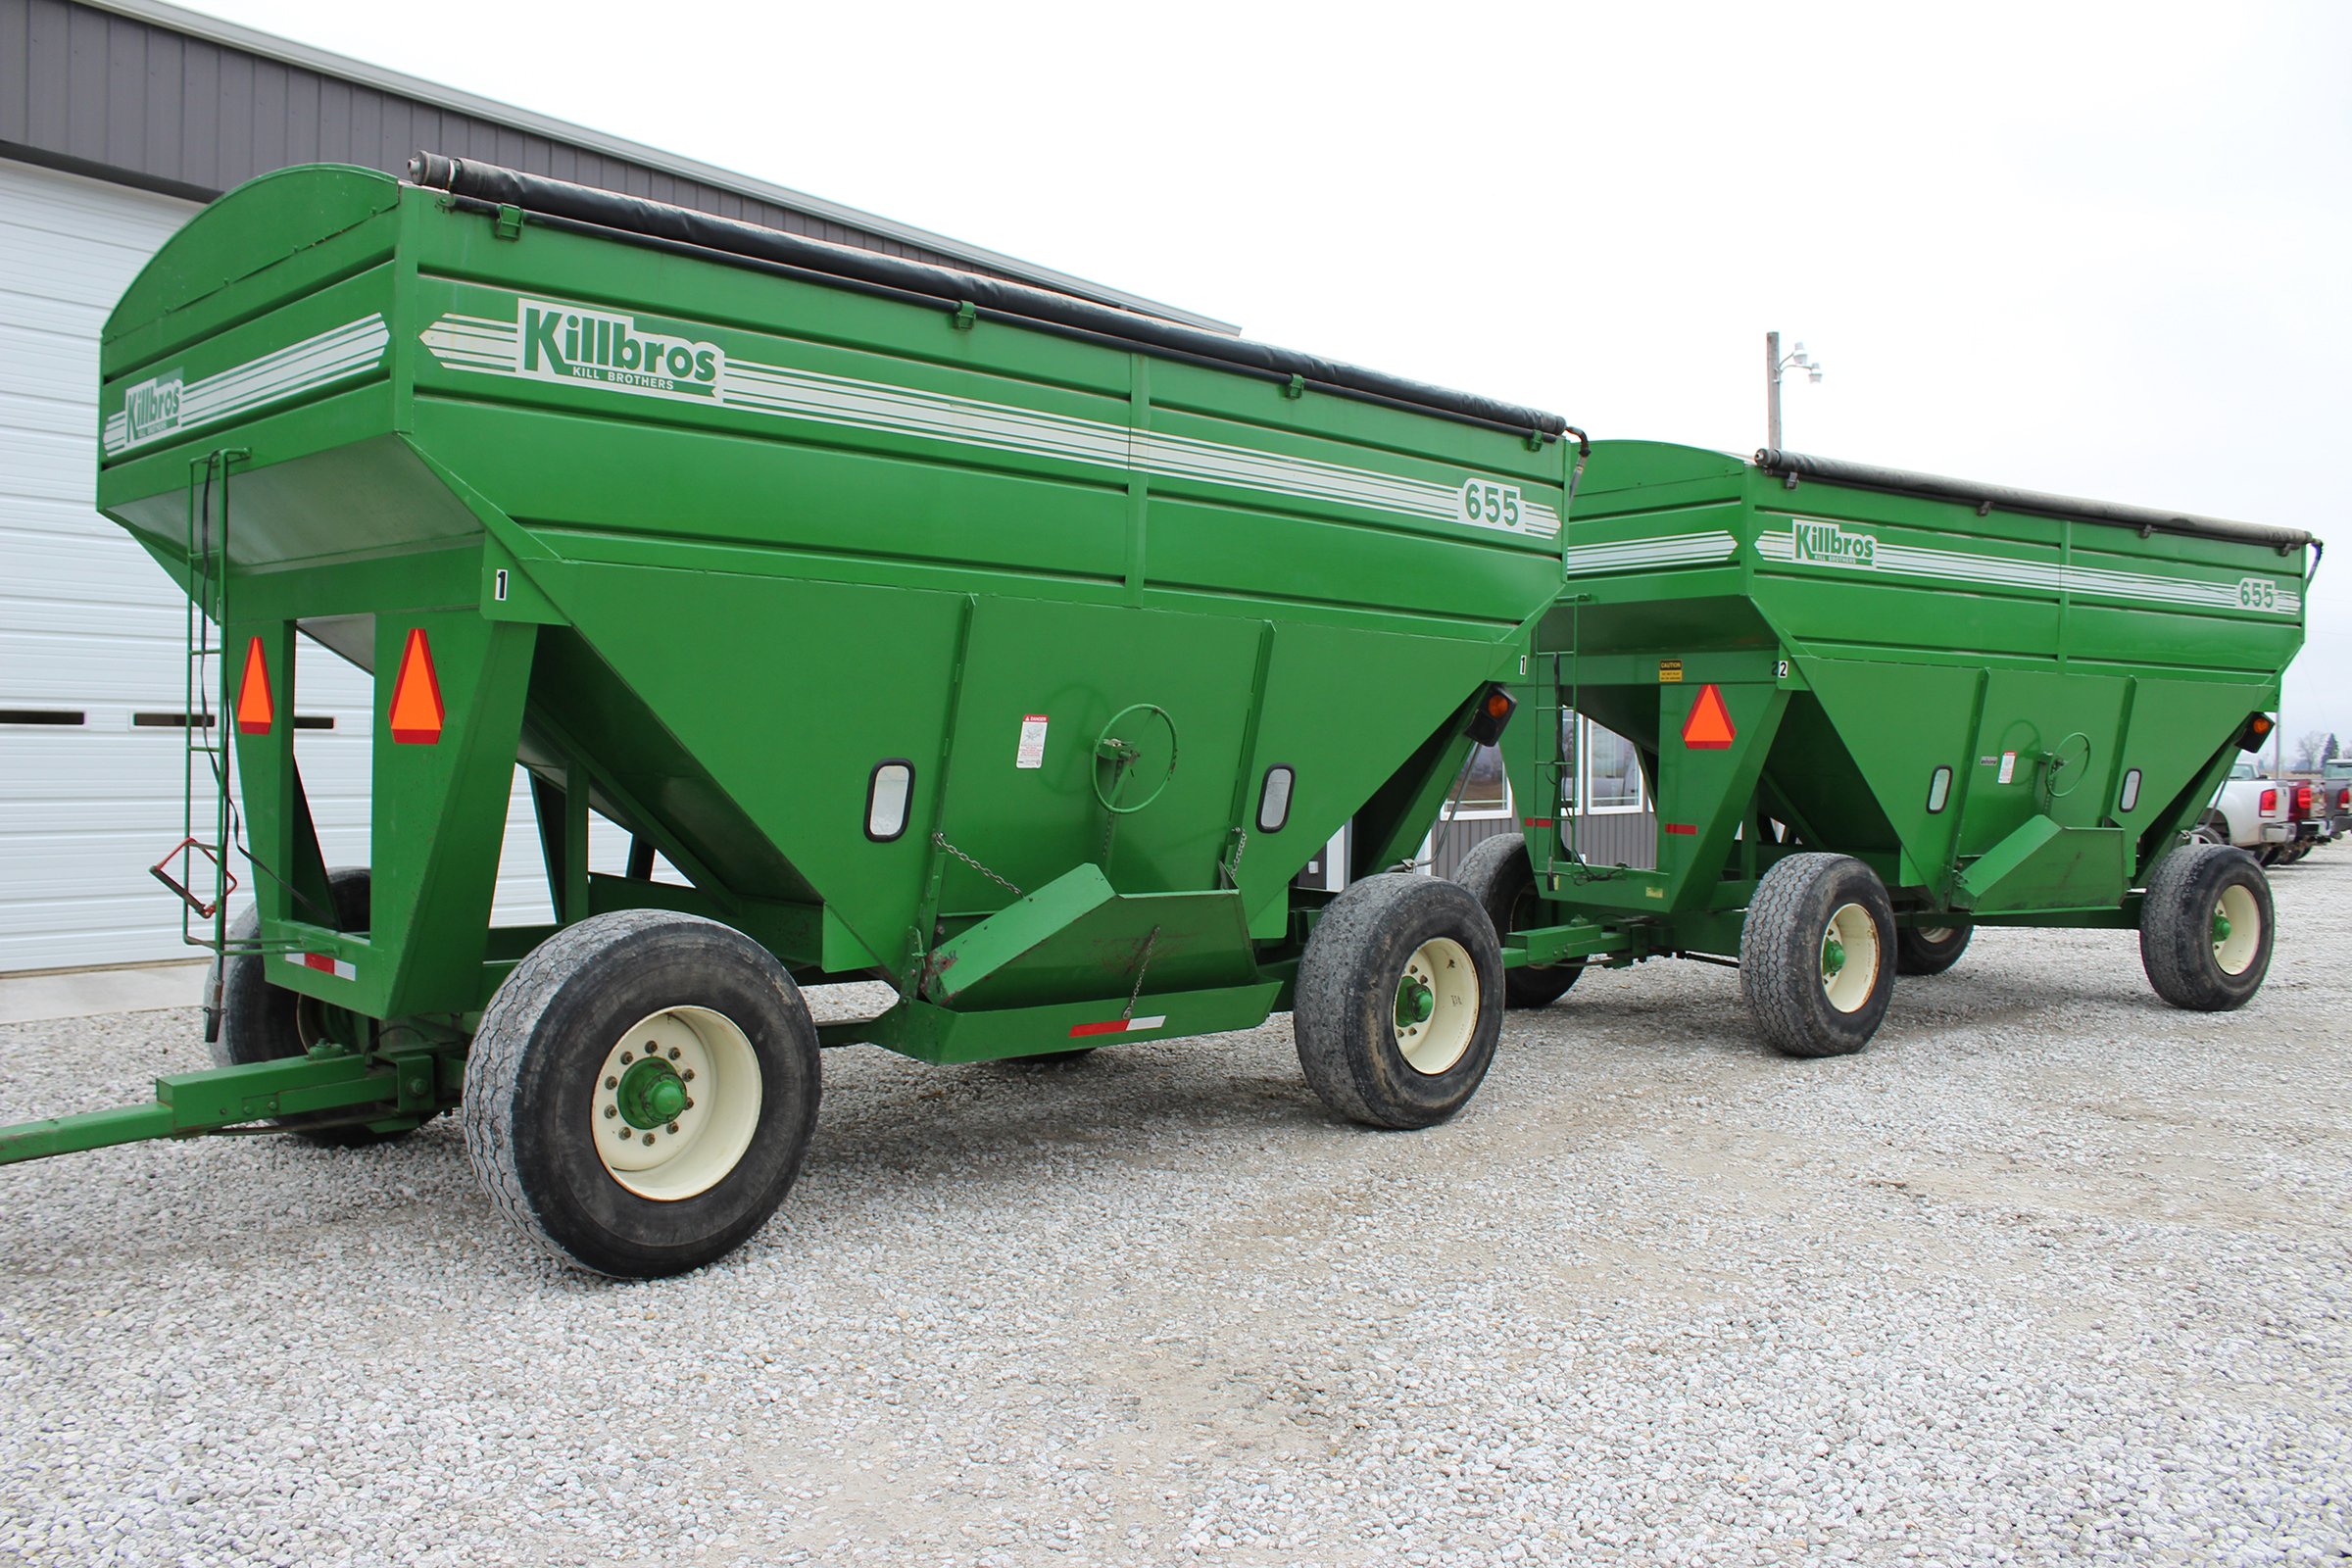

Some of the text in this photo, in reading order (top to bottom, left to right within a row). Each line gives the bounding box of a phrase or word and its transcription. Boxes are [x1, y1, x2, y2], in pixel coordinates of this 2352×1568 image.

[523, 307, 716, 382] Killbros
[572, 366, 674, 390] KILL BROTHERS
[126, 385, 179, 443] Killbros
[1465, 483, 1519, 527] 655
[1795, 523, 1874, 559] Killbros
[497, 570, 507, 600] 1
[2241, 581, 2274, 609] 655
[1780, 662, 1788, 677] 2
